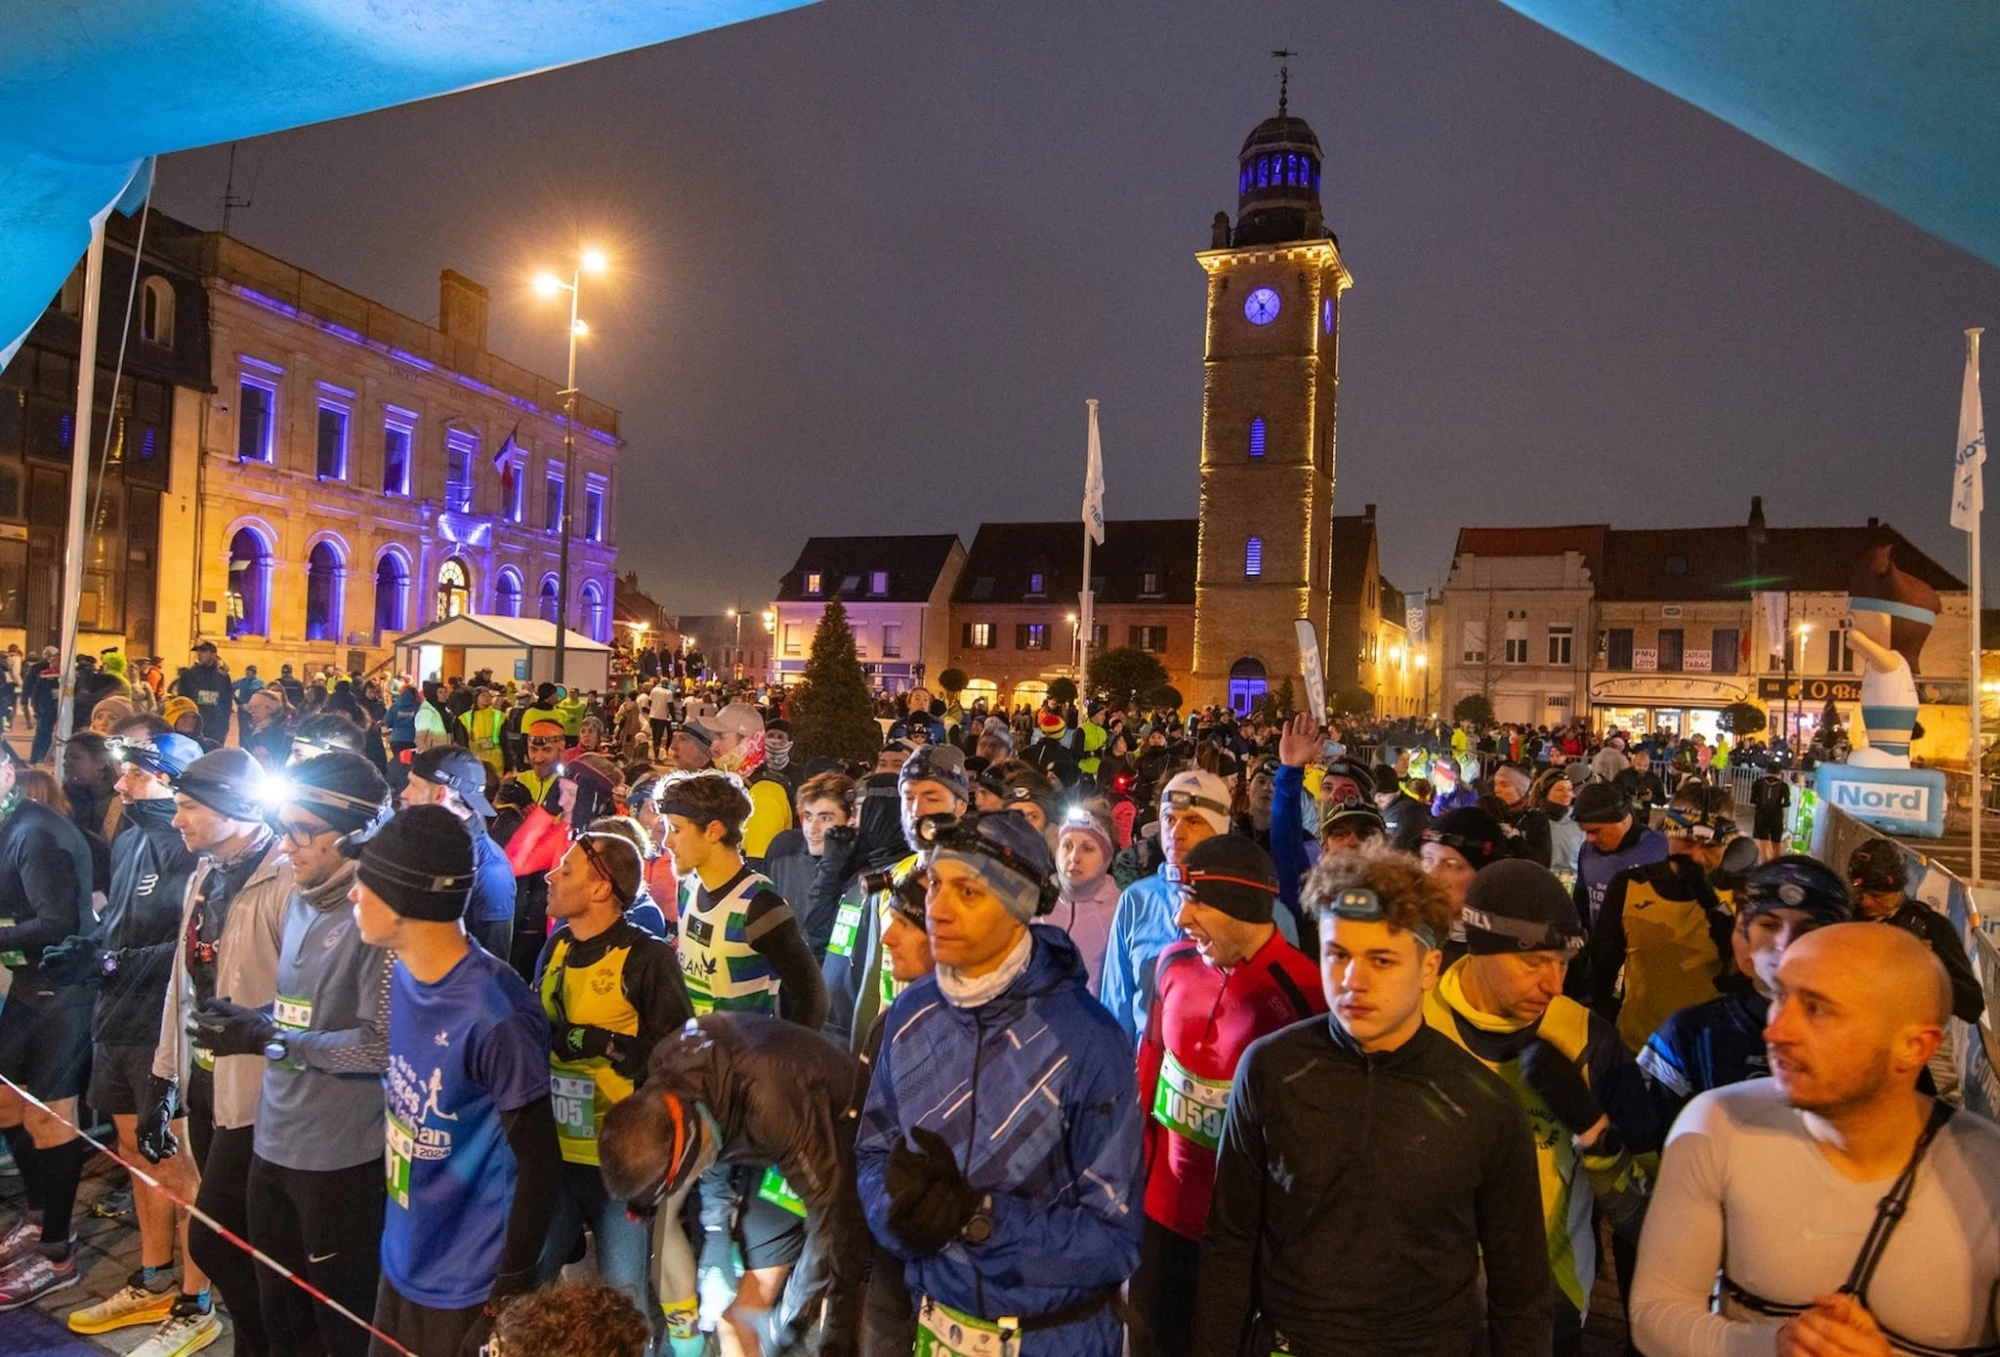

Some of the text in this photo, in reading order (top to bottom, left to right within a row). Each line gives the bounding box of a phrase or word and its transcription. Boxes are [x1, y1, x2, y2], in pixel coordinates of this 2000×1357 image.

[1634, 650, 1656, 658] PMU
[1684, 651, 1711, 659] CADEAUX
[1684, 661, 1711, 669] TABAC
[1810, 680, 1829, 699] O
[1837, 785, 1922, 811] Nord
[1164, 1087, 1223, 1138] 1059
[419, 1147, 450, 1158] 2024
